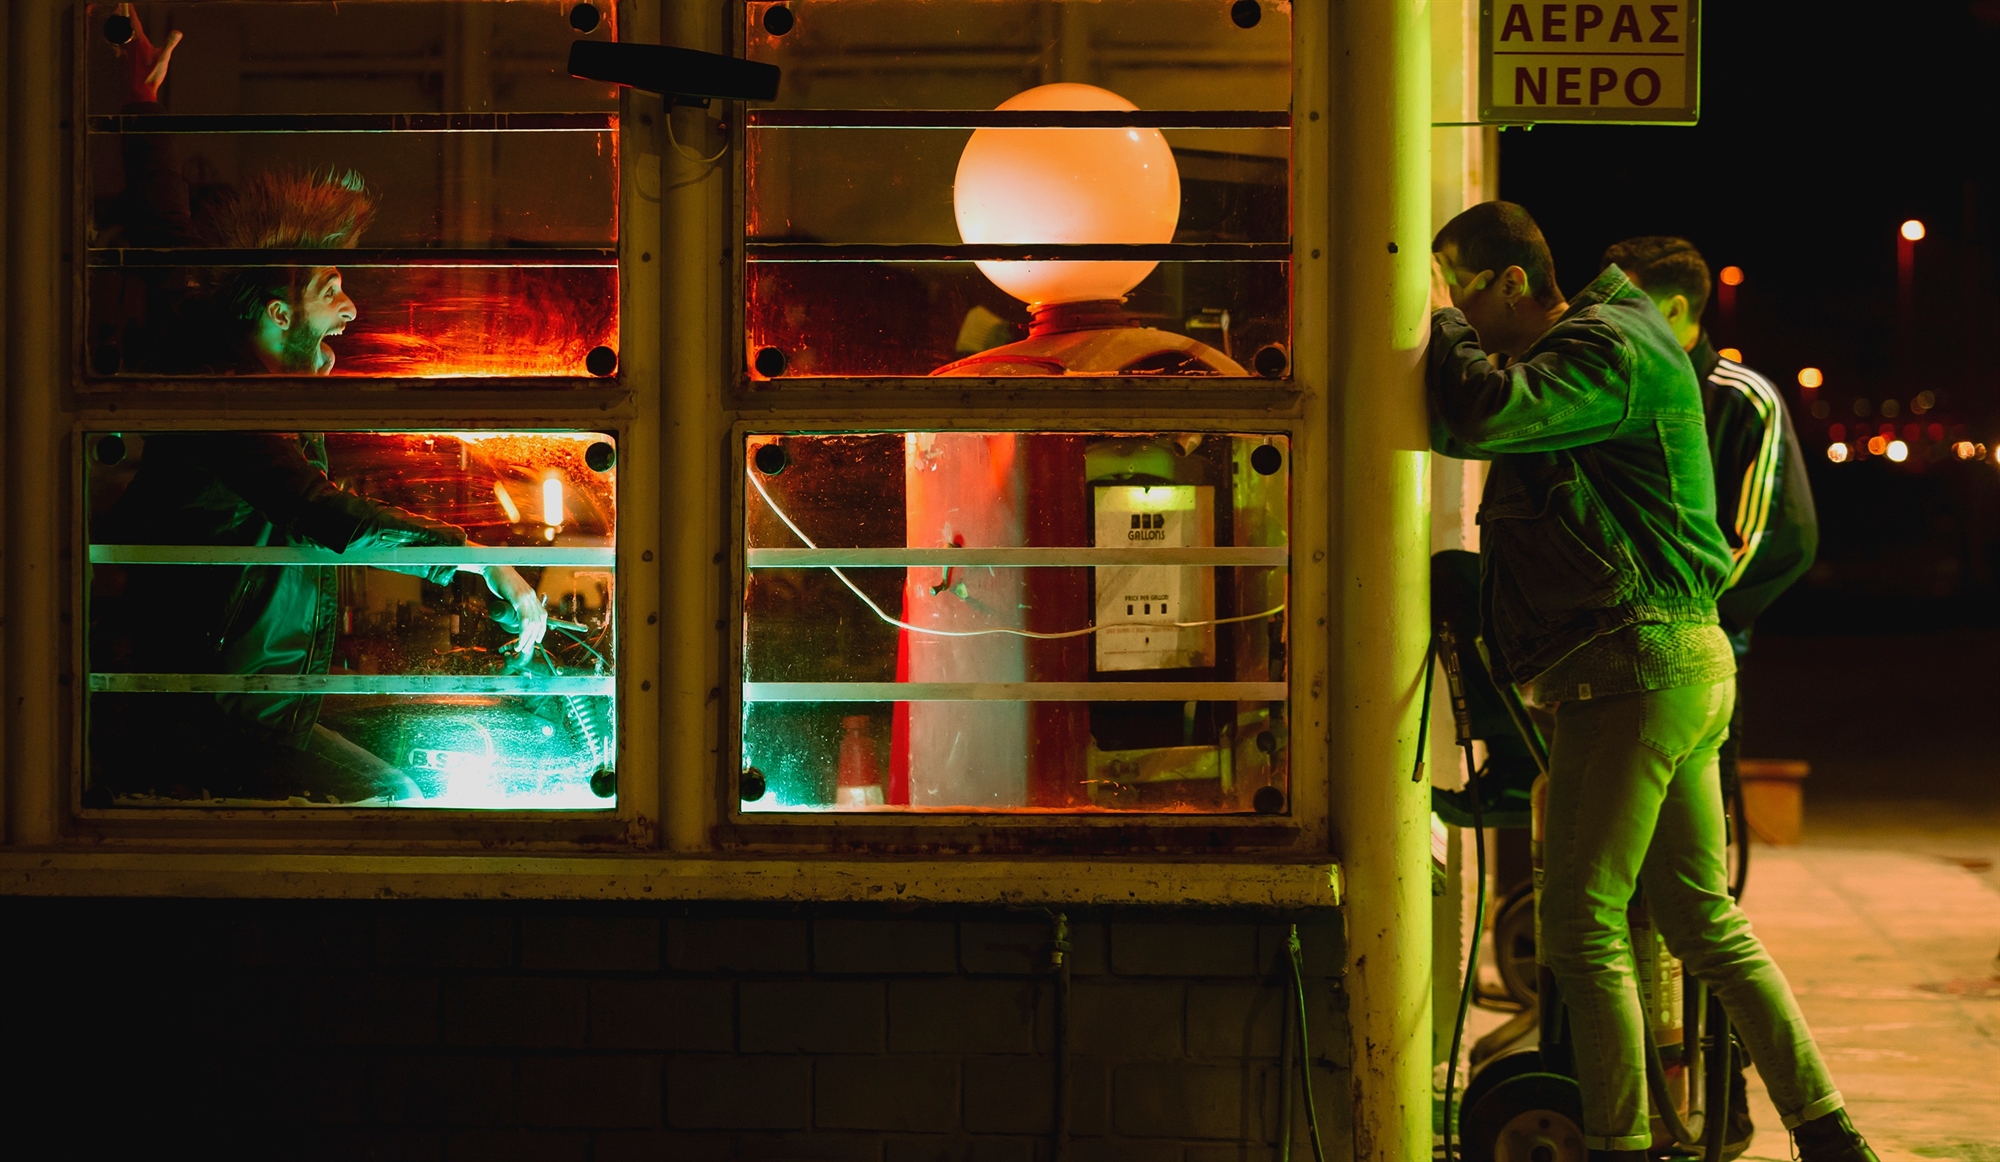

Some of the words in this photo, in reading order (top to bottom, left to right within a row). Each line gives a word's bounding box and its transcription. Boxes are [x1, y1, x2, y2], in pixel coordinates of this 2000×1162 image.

[1500, 4, 1679, 43] ΑΕΡΑΣ
[1515, 66, 1661, 106] ΝΕΡΟ
[1128, 530, 1165, 541] GALLONS
